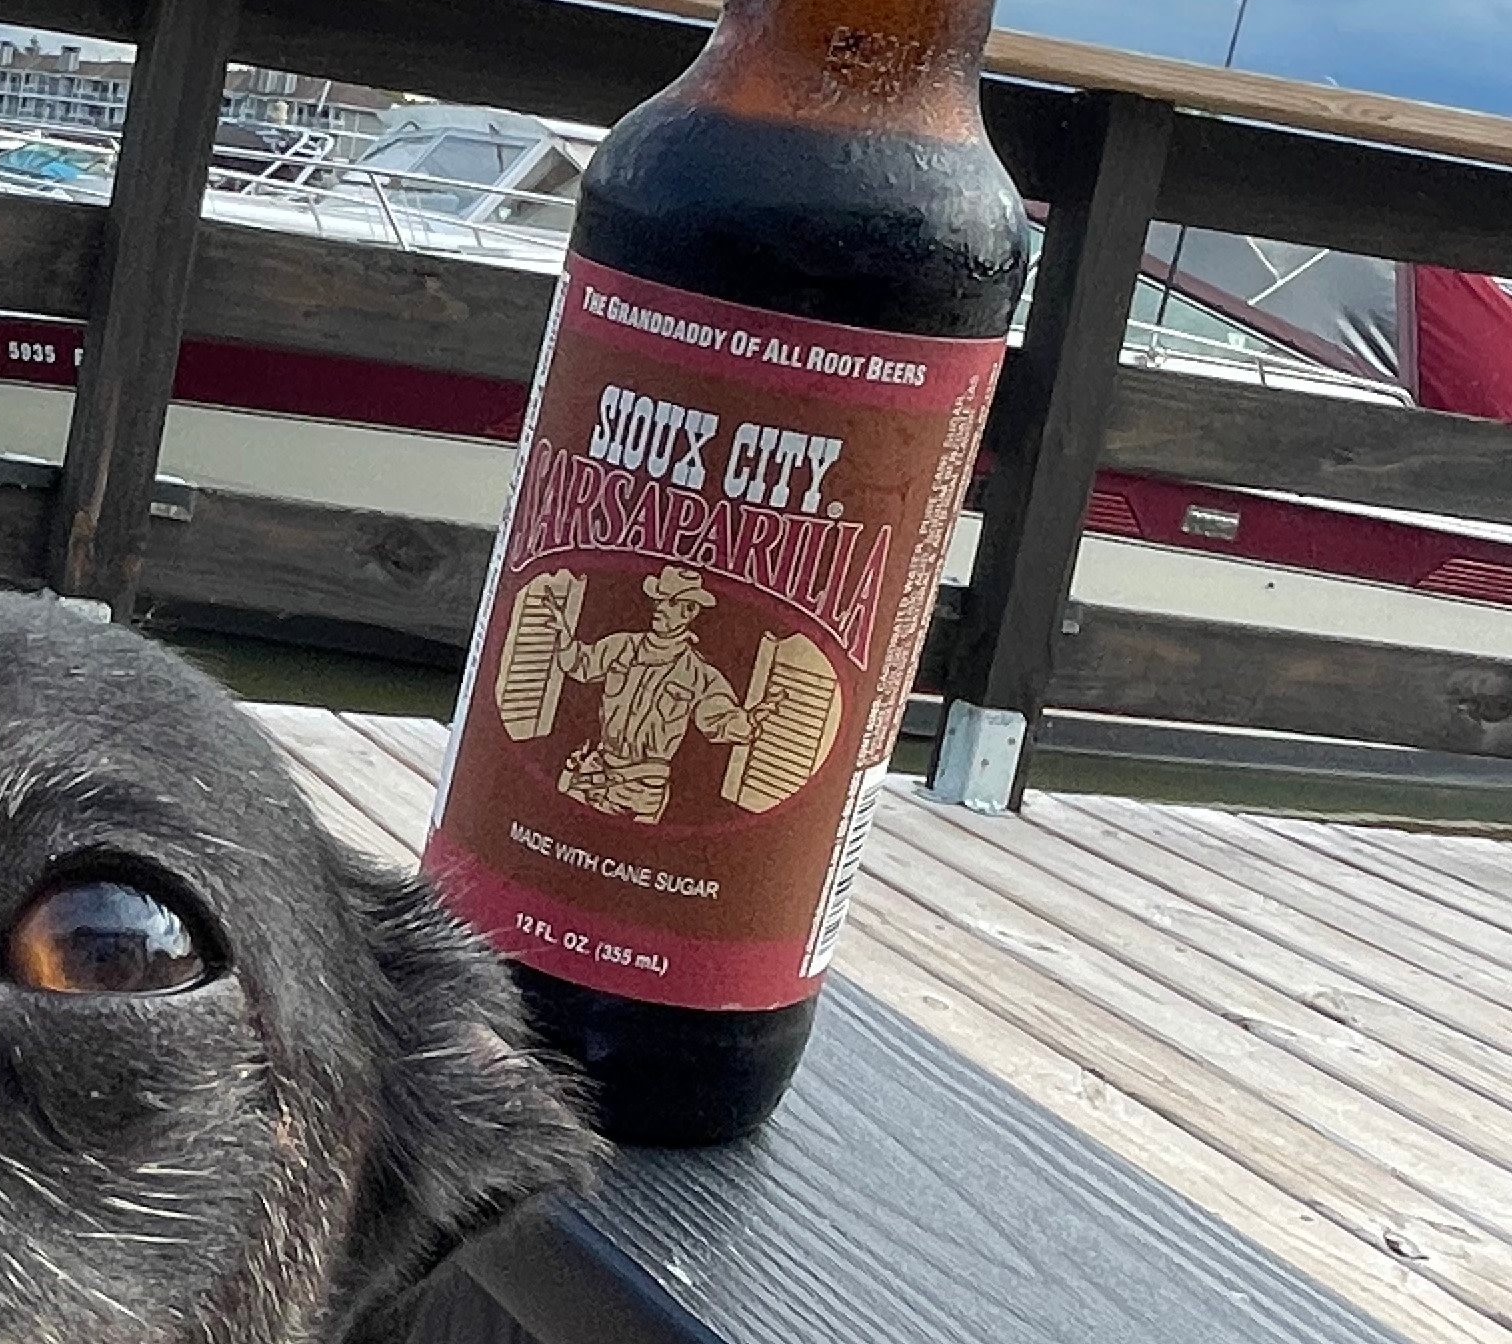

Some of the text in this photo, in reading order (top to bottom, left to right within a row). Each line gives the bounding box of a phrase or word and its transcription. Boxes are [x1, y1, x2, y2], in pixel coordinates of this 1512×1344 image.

[807, 347, 865, 378] ROOT
[866, 356, 928, 387] BEERS
[589, 384, 720, 491] SIOUX
[510, 439, 892, 671] SARSAPARILLA
[510, 820, 720, 900] MADE WITH CANE SUGAR
[515, 912, 533, 934] 12
[594, 941, 633, 967] (355
[634, 954, 669, 977] mL)
